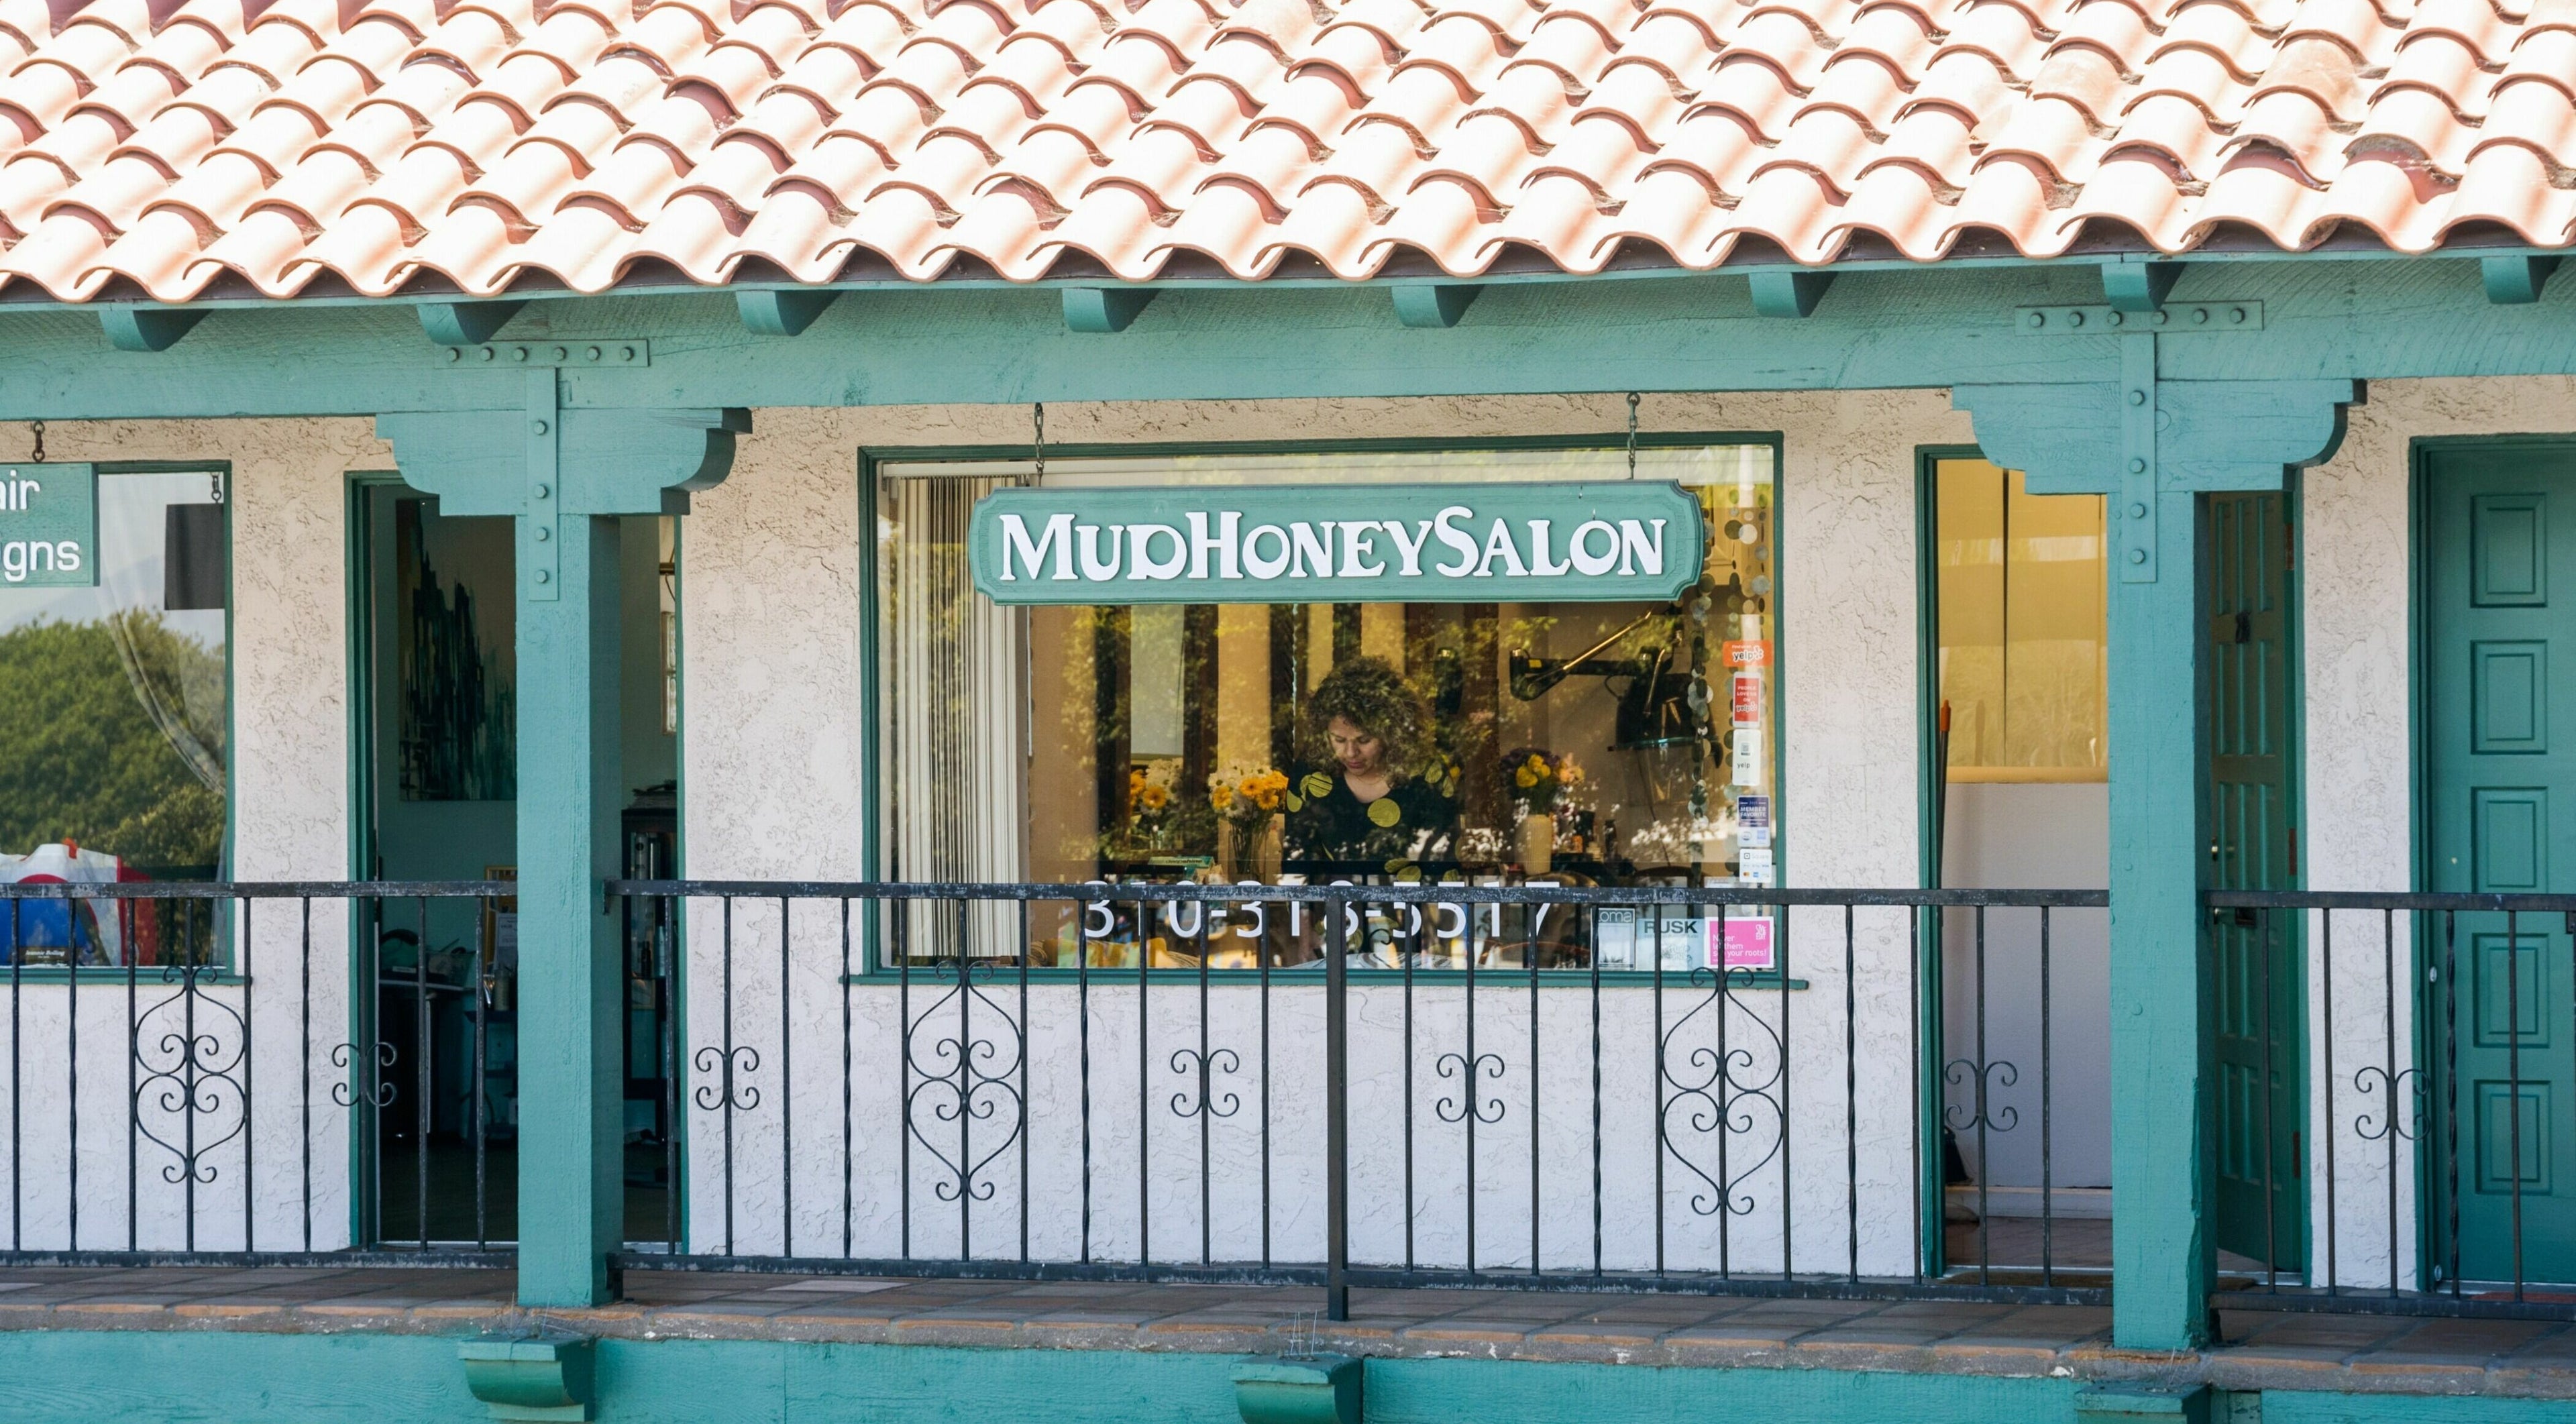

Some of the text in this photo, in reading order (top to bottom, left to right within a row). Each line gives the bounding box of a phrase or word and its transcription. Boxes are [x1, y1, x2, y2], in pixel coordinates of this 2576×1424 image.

[0, 470, 40, 510] ir
[1733, 651, 1753, 661] yelp
[1083, 881, 1560, 938] 30-31-5517
[1599, 911, 1632, 922] oma
[1644, 920, 1698, 934] RUSK
[1727, 950, 1743, 958] your
